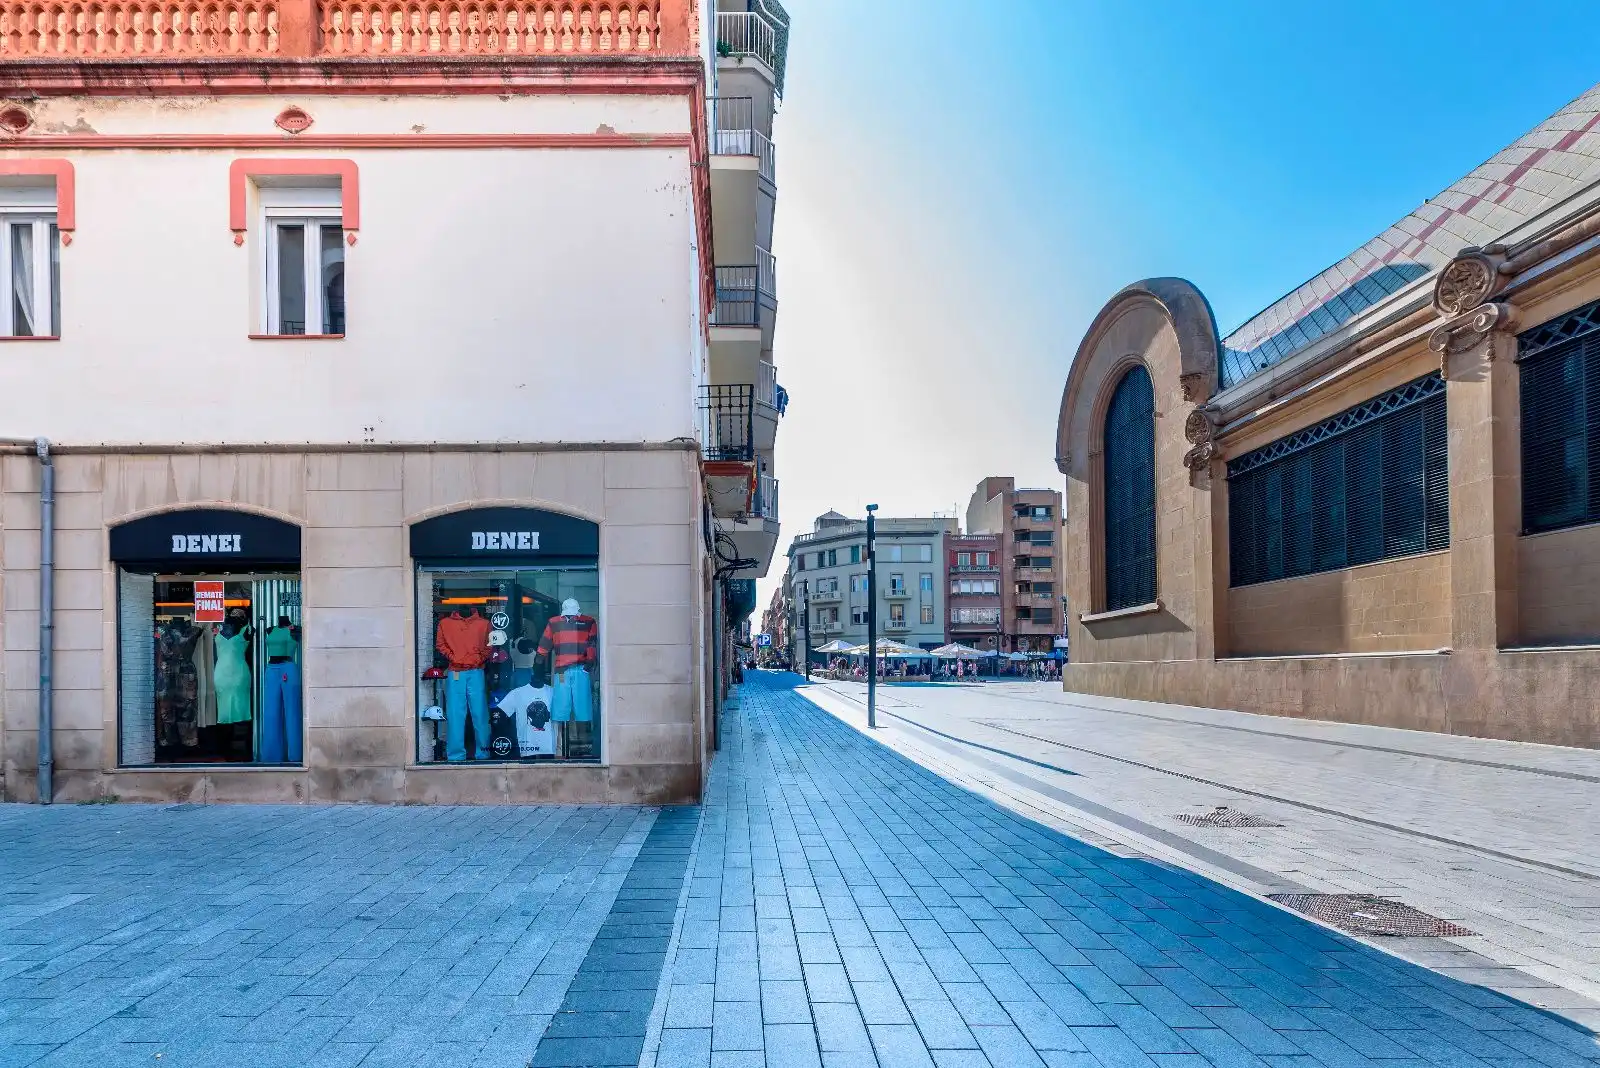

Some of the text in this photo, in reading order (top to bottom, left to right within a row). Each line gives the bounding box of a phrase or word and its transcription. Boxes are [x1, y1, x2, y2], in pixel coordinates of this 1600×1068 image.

[172, 534, 241, 553] DENEI
[471, 532, 540, 550] DENEI
[195, 591, 224, 599] REMATE
[196, 600, 224, 611] FINAL
